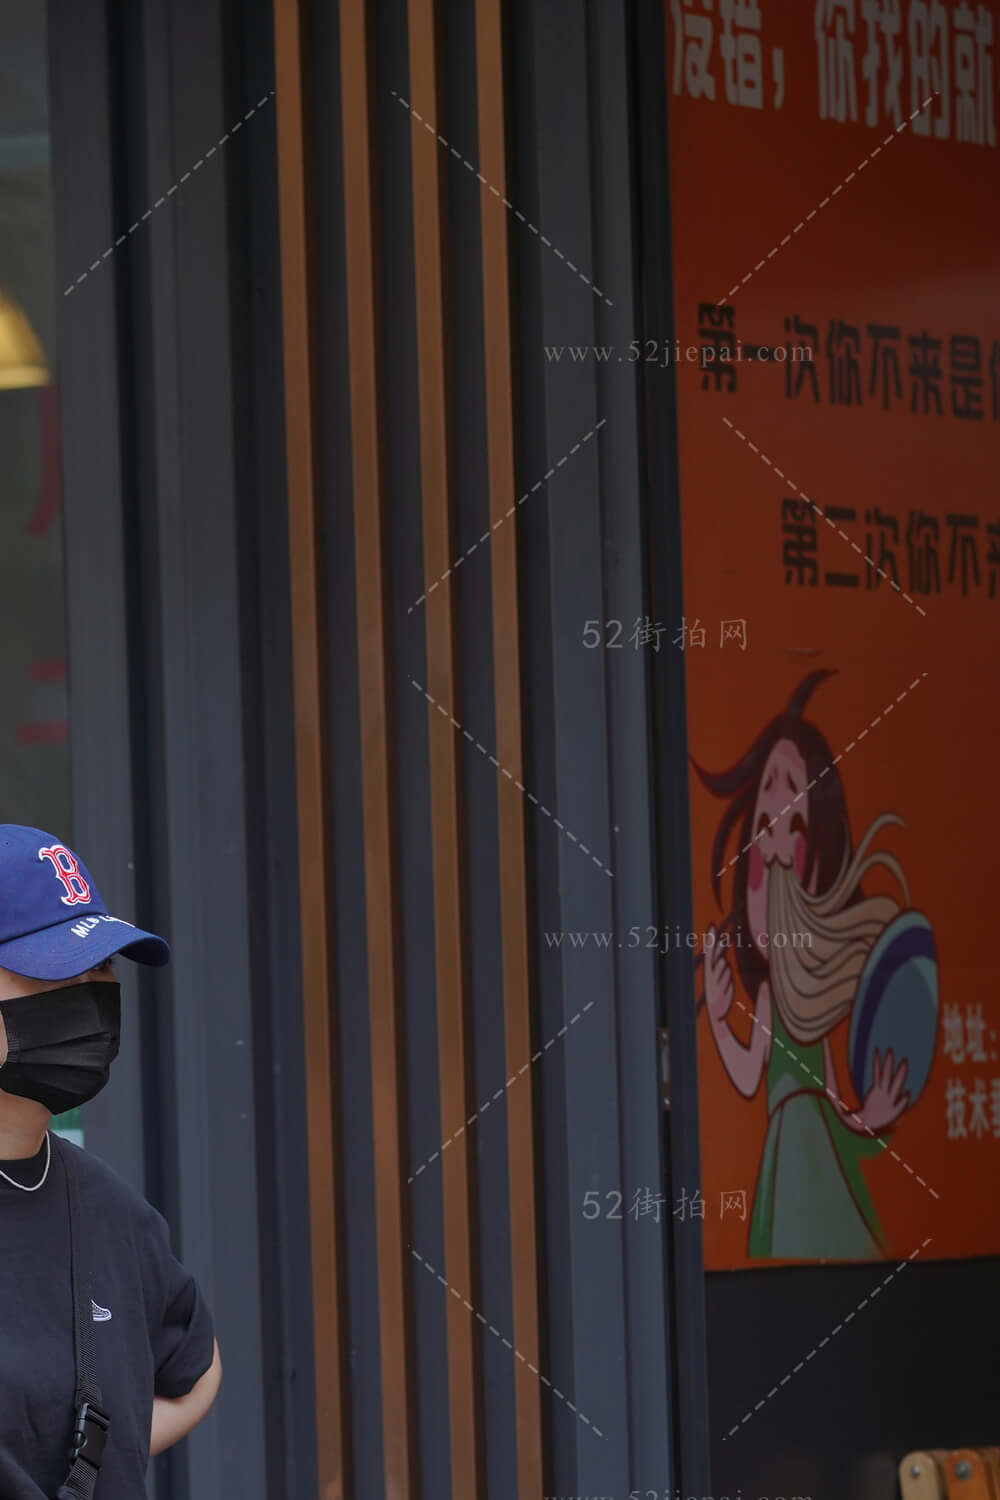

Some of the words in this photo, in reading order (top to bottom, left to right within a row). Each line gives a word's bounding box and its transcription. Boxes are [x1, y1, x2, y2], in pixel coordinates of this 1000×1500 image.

[698, 302, 1000, 422] 第一次你不来是
[38, 844, 92, 906] B
